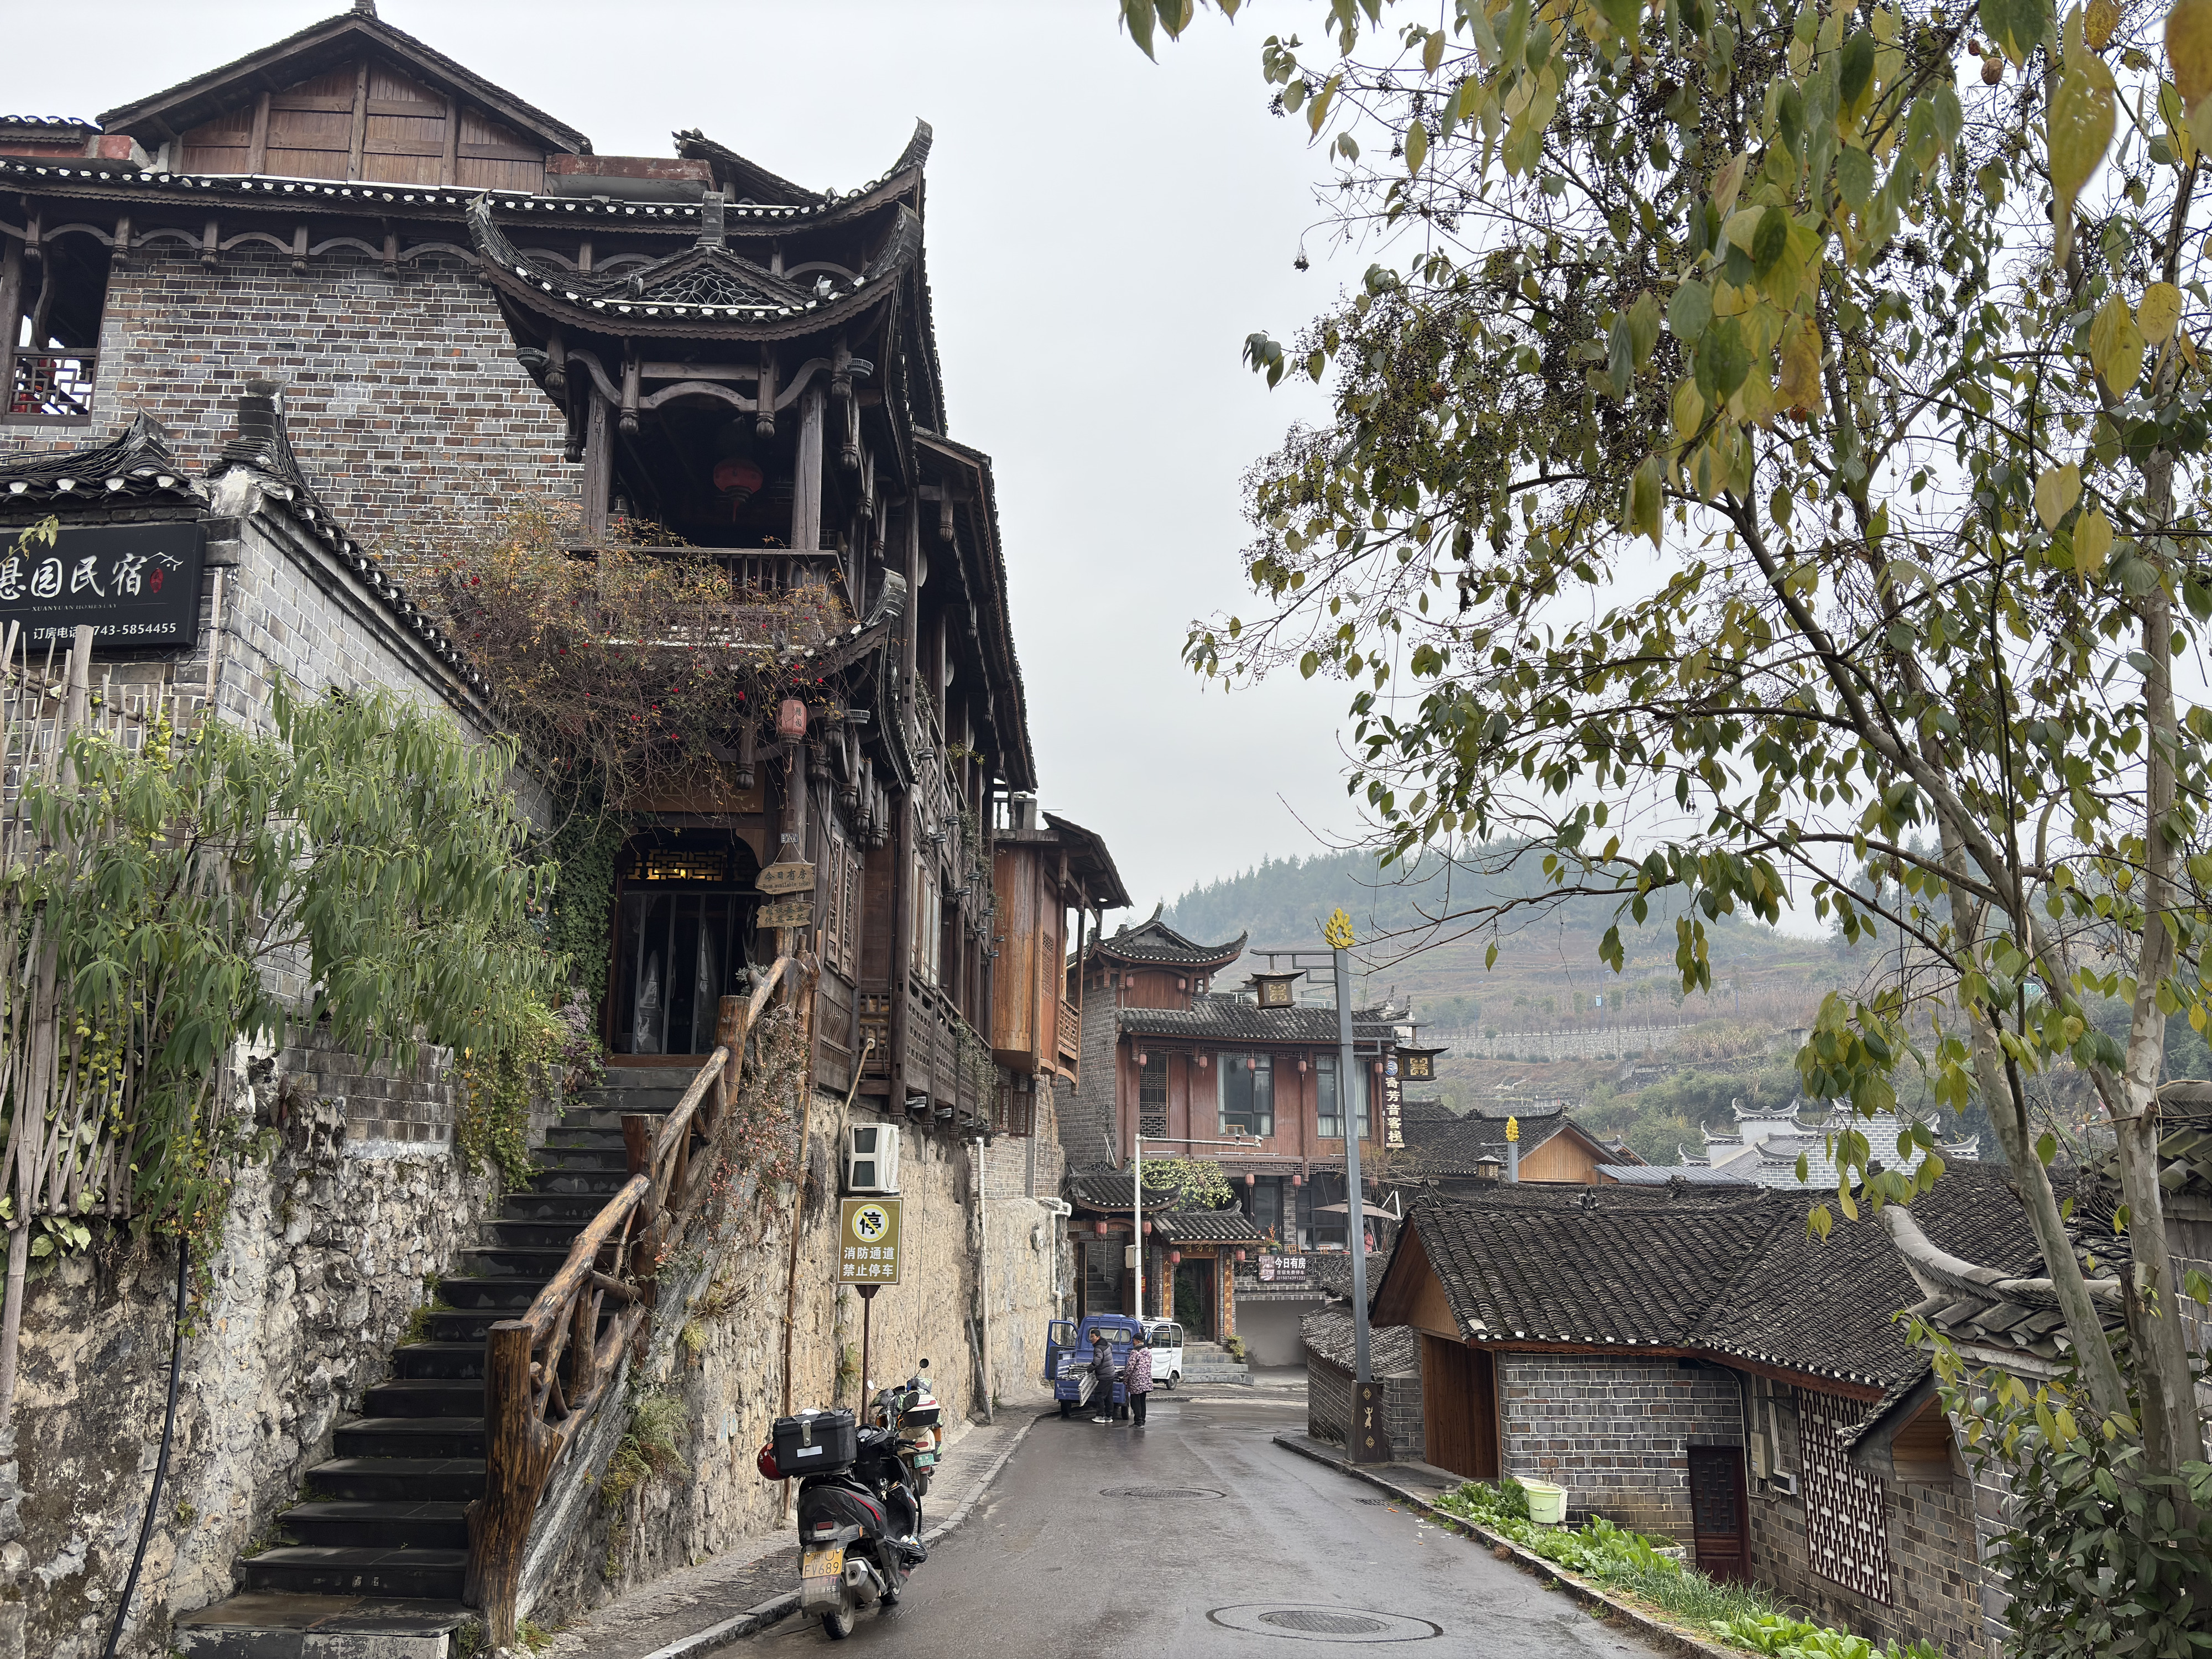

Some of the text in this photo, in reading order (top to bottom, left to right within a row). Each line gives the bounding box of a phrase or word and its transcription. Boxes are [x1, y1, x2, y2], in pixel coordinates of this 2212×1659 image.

[93, 623, 176, 635] 743-5854455
[765, 869, 807, 881] 今日有房
[1385, 1077, 1402, 1142] 寄芳音客栈
[844, 1246, 895, 1260] 消防通道
[1275, 1257, 1306, 1269] 今日有房
[843, 1264, 894, 1277] 禁止停车
[804, 1562, 839, 1577] FV689
